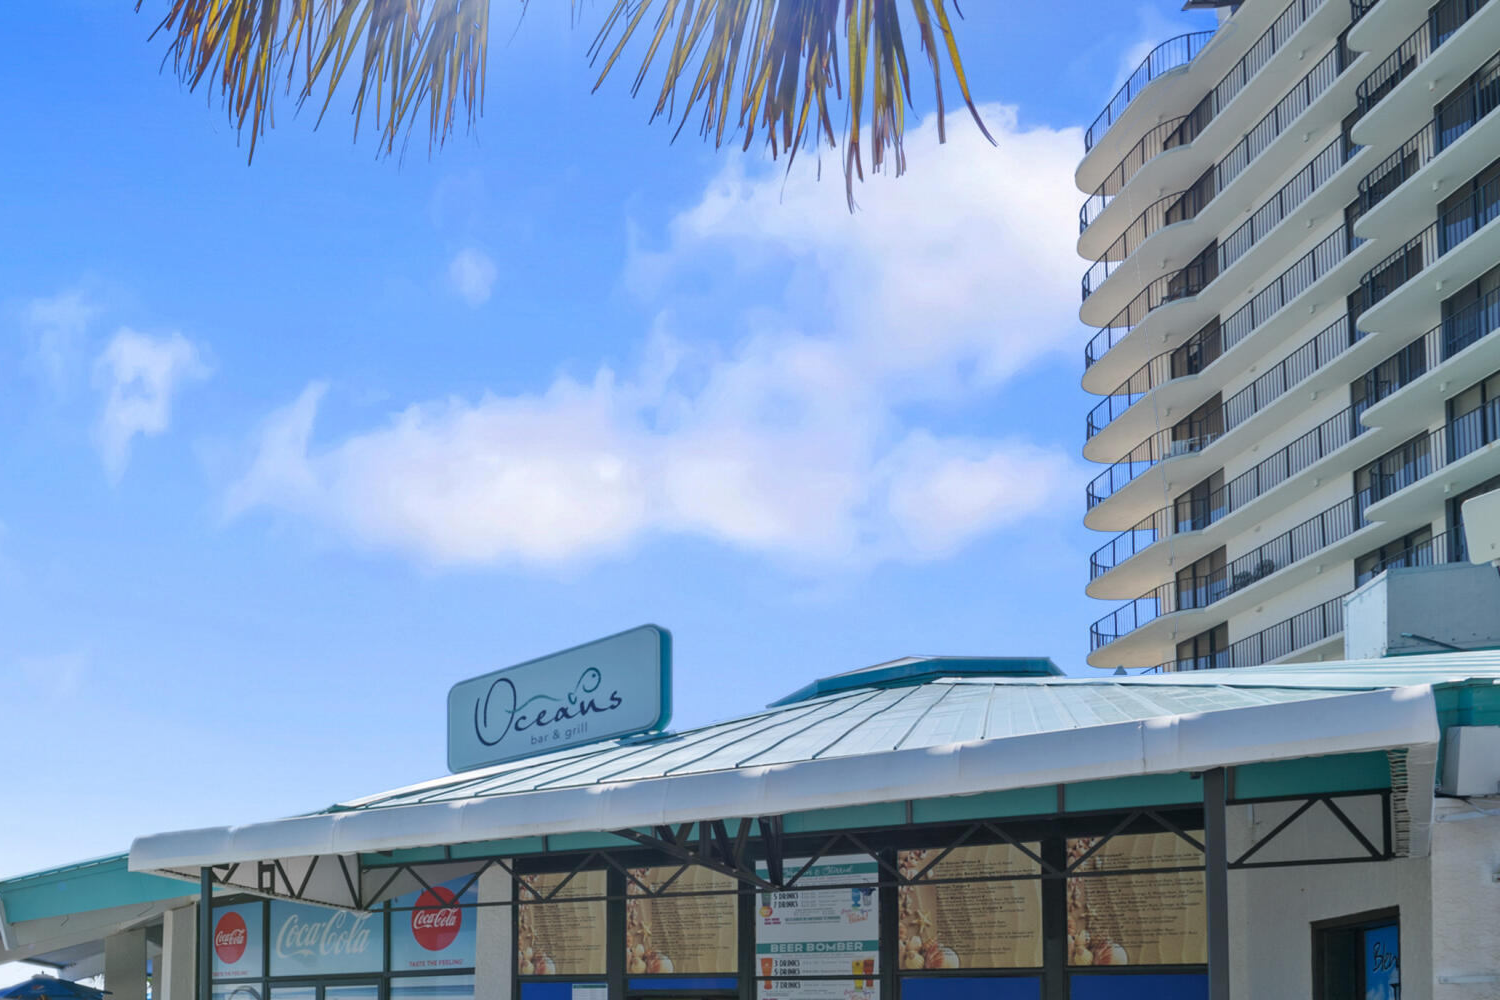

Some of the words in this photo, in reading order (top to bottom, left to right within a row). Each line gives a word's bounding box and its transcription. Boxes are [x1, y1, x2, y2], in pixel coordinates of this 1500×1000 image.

[474, 678, 623, 746] Oceans
[531, 733, 549, 745] bar
[553, 730, 560, 739] &
[565, 722, 588, 741] grill
[779, 892, 799, 900] DRINKS
[770, 943, 803, 953] BEER
[807, 942, 863, 952] BOMBER
[780, 959, 800, 967] DRINKS
[780, 968, 800, 976] DRINKS
[780, 981, 801, 989] DRINKS
